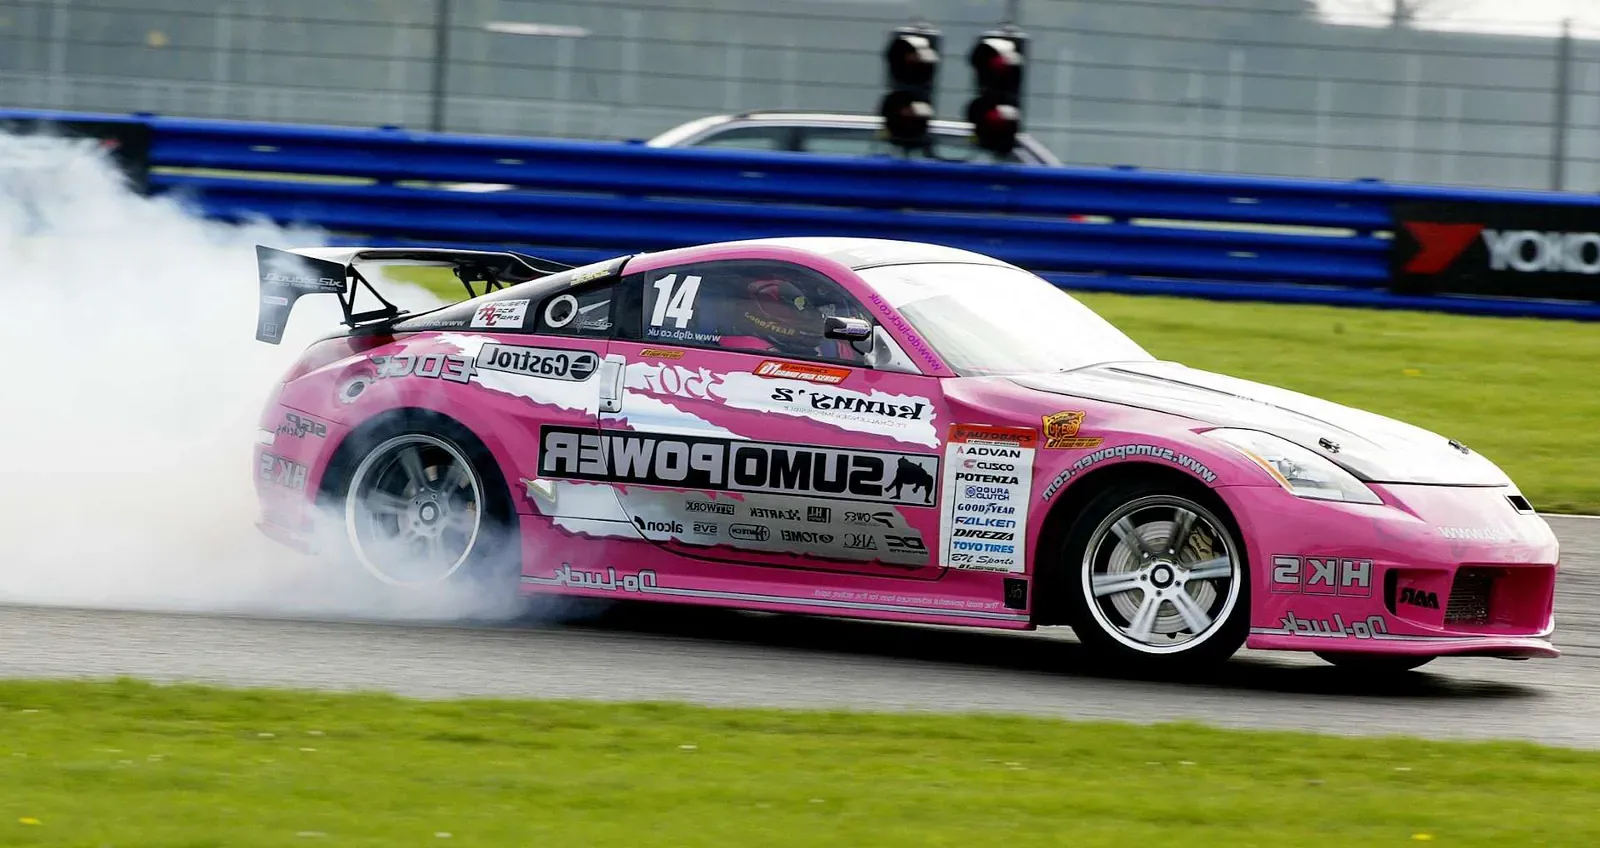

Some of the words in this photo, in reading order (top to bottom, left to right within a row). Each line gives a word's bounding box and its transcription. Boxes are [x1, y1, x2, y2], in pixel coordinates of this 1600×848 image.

[650, 273, 702, 329] 14
[966, 447, 1021, 458] ADVAN
[977, 462, 1015, 471] CUSCO
[955, 472, 1019, 485] POTENZA
[957, 503, 1015, 514] GOODYEAR
[955, 516, 1016, 528] FALKEN
[953, 528, 1014, 541] DIREZZA
[953, 541, 983, 552] TOYO
[984, 543, 1015, 554] TIRES
[976, 555, 1014, 565] Sports
